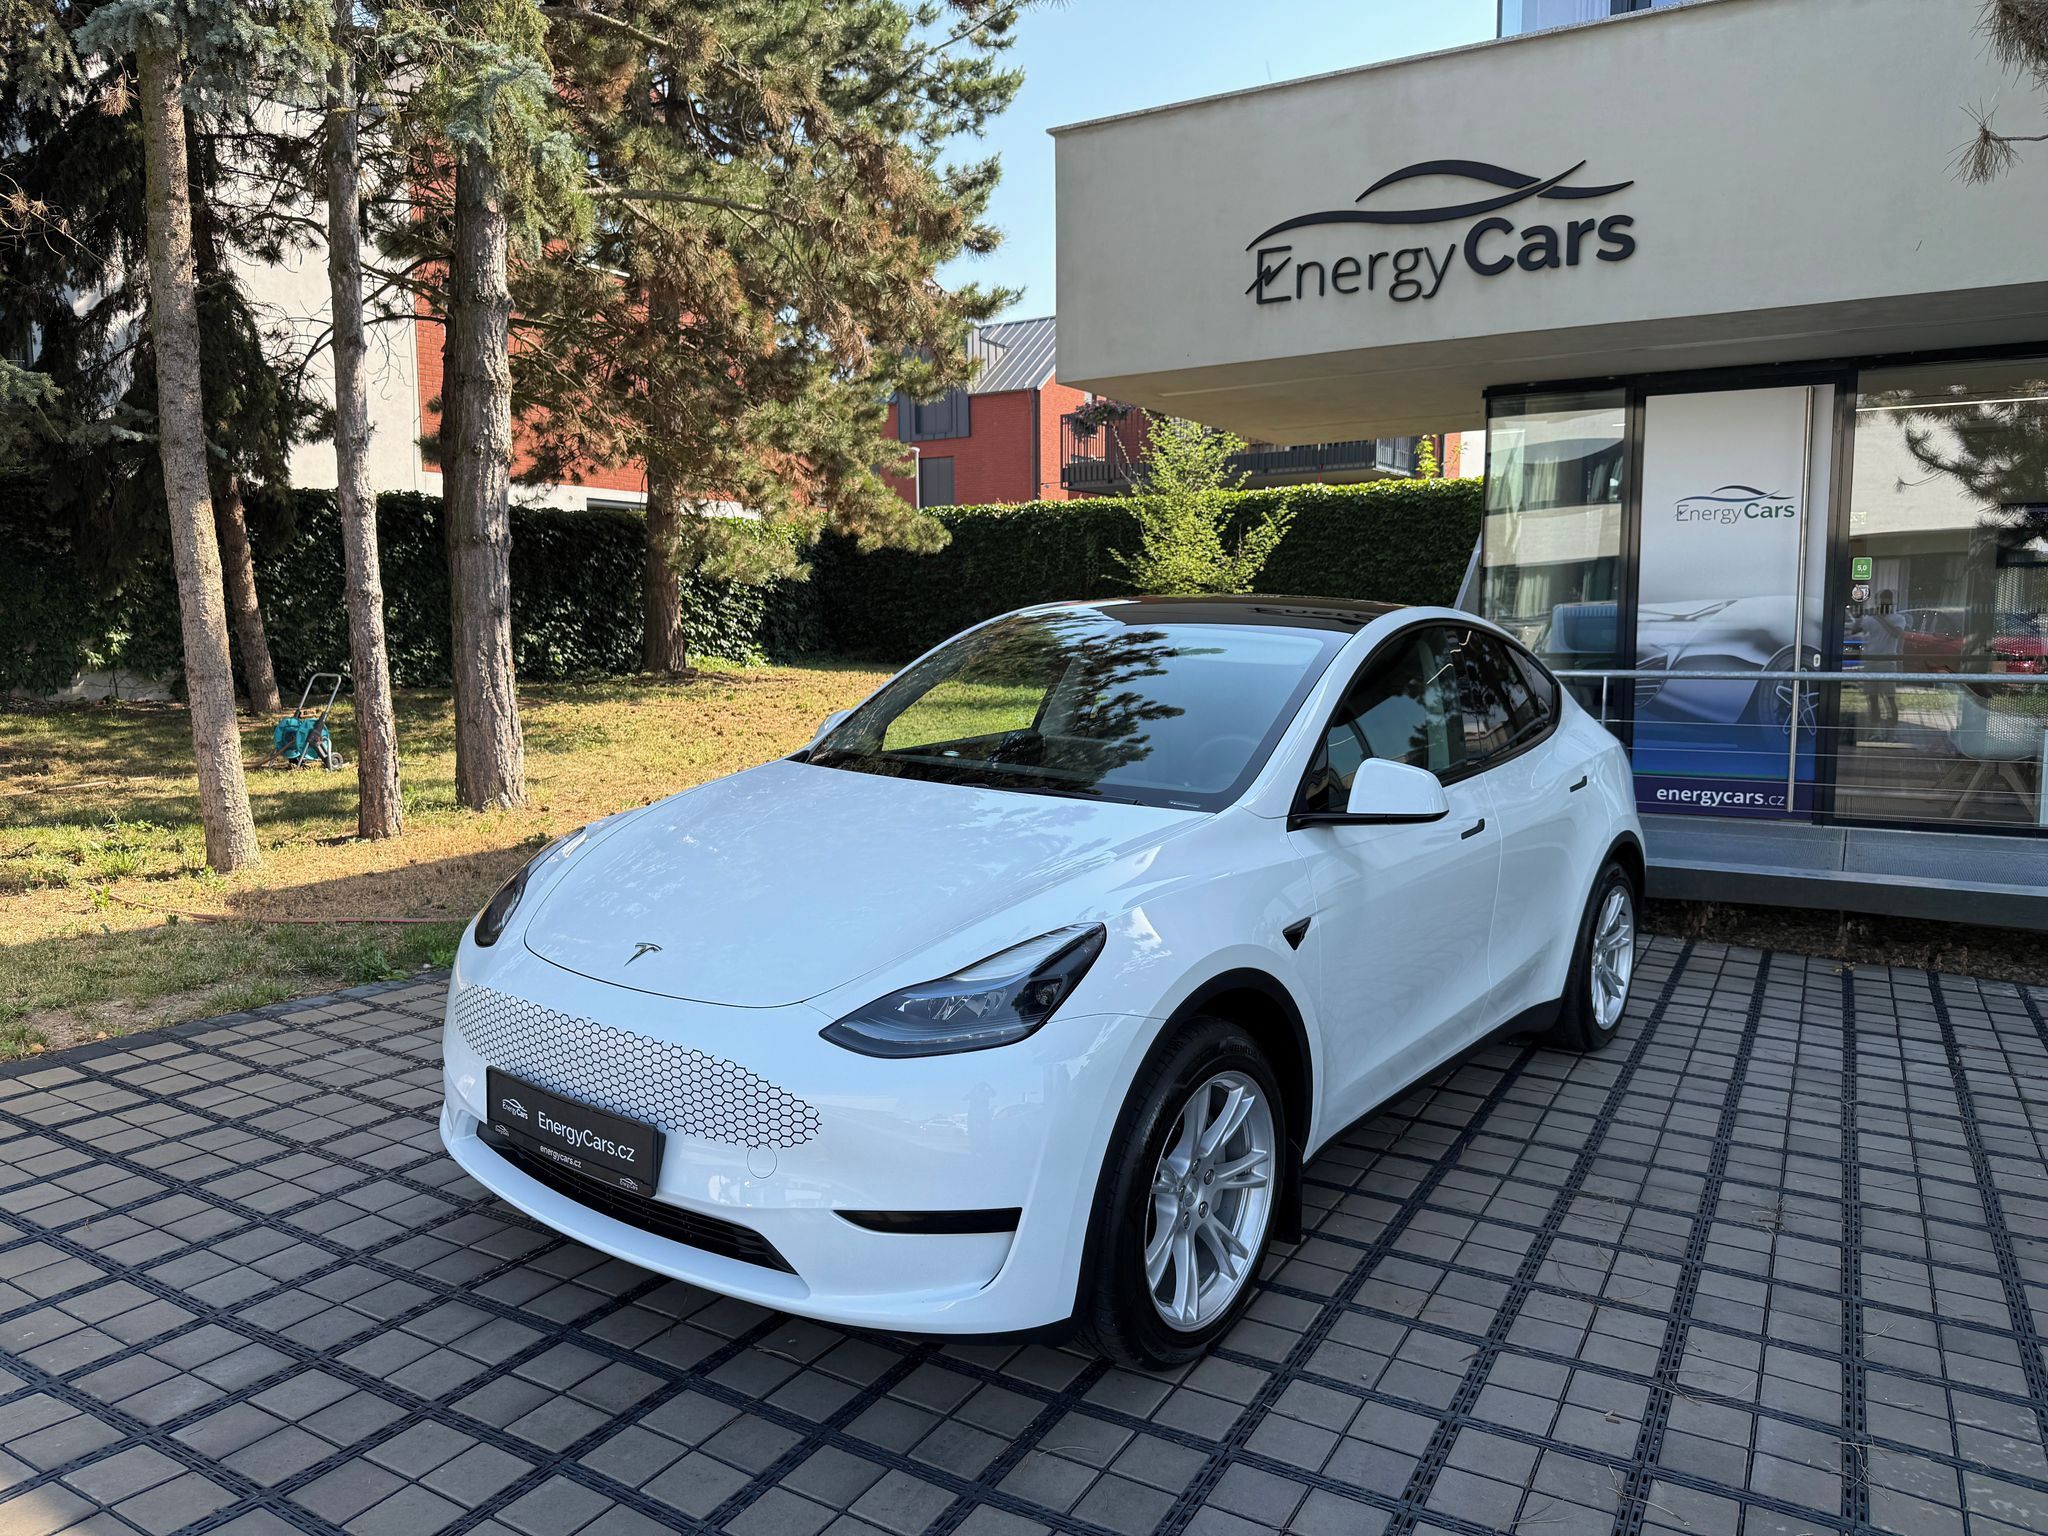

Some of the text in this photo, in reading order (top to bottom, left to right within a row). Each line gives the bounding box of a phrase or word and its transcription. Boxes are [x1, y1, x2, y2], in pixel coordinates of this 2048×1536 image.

[1246, 214, 1636, 304] EnergyCars
[1674, 502, 1795, 525] EnergyCars
[1656, 788, 1785, 807] energycars.cz
[538, 1110, 636, 1163] EnergyCars.cz
[539, 1144, 582, 1169] energycars.cz
